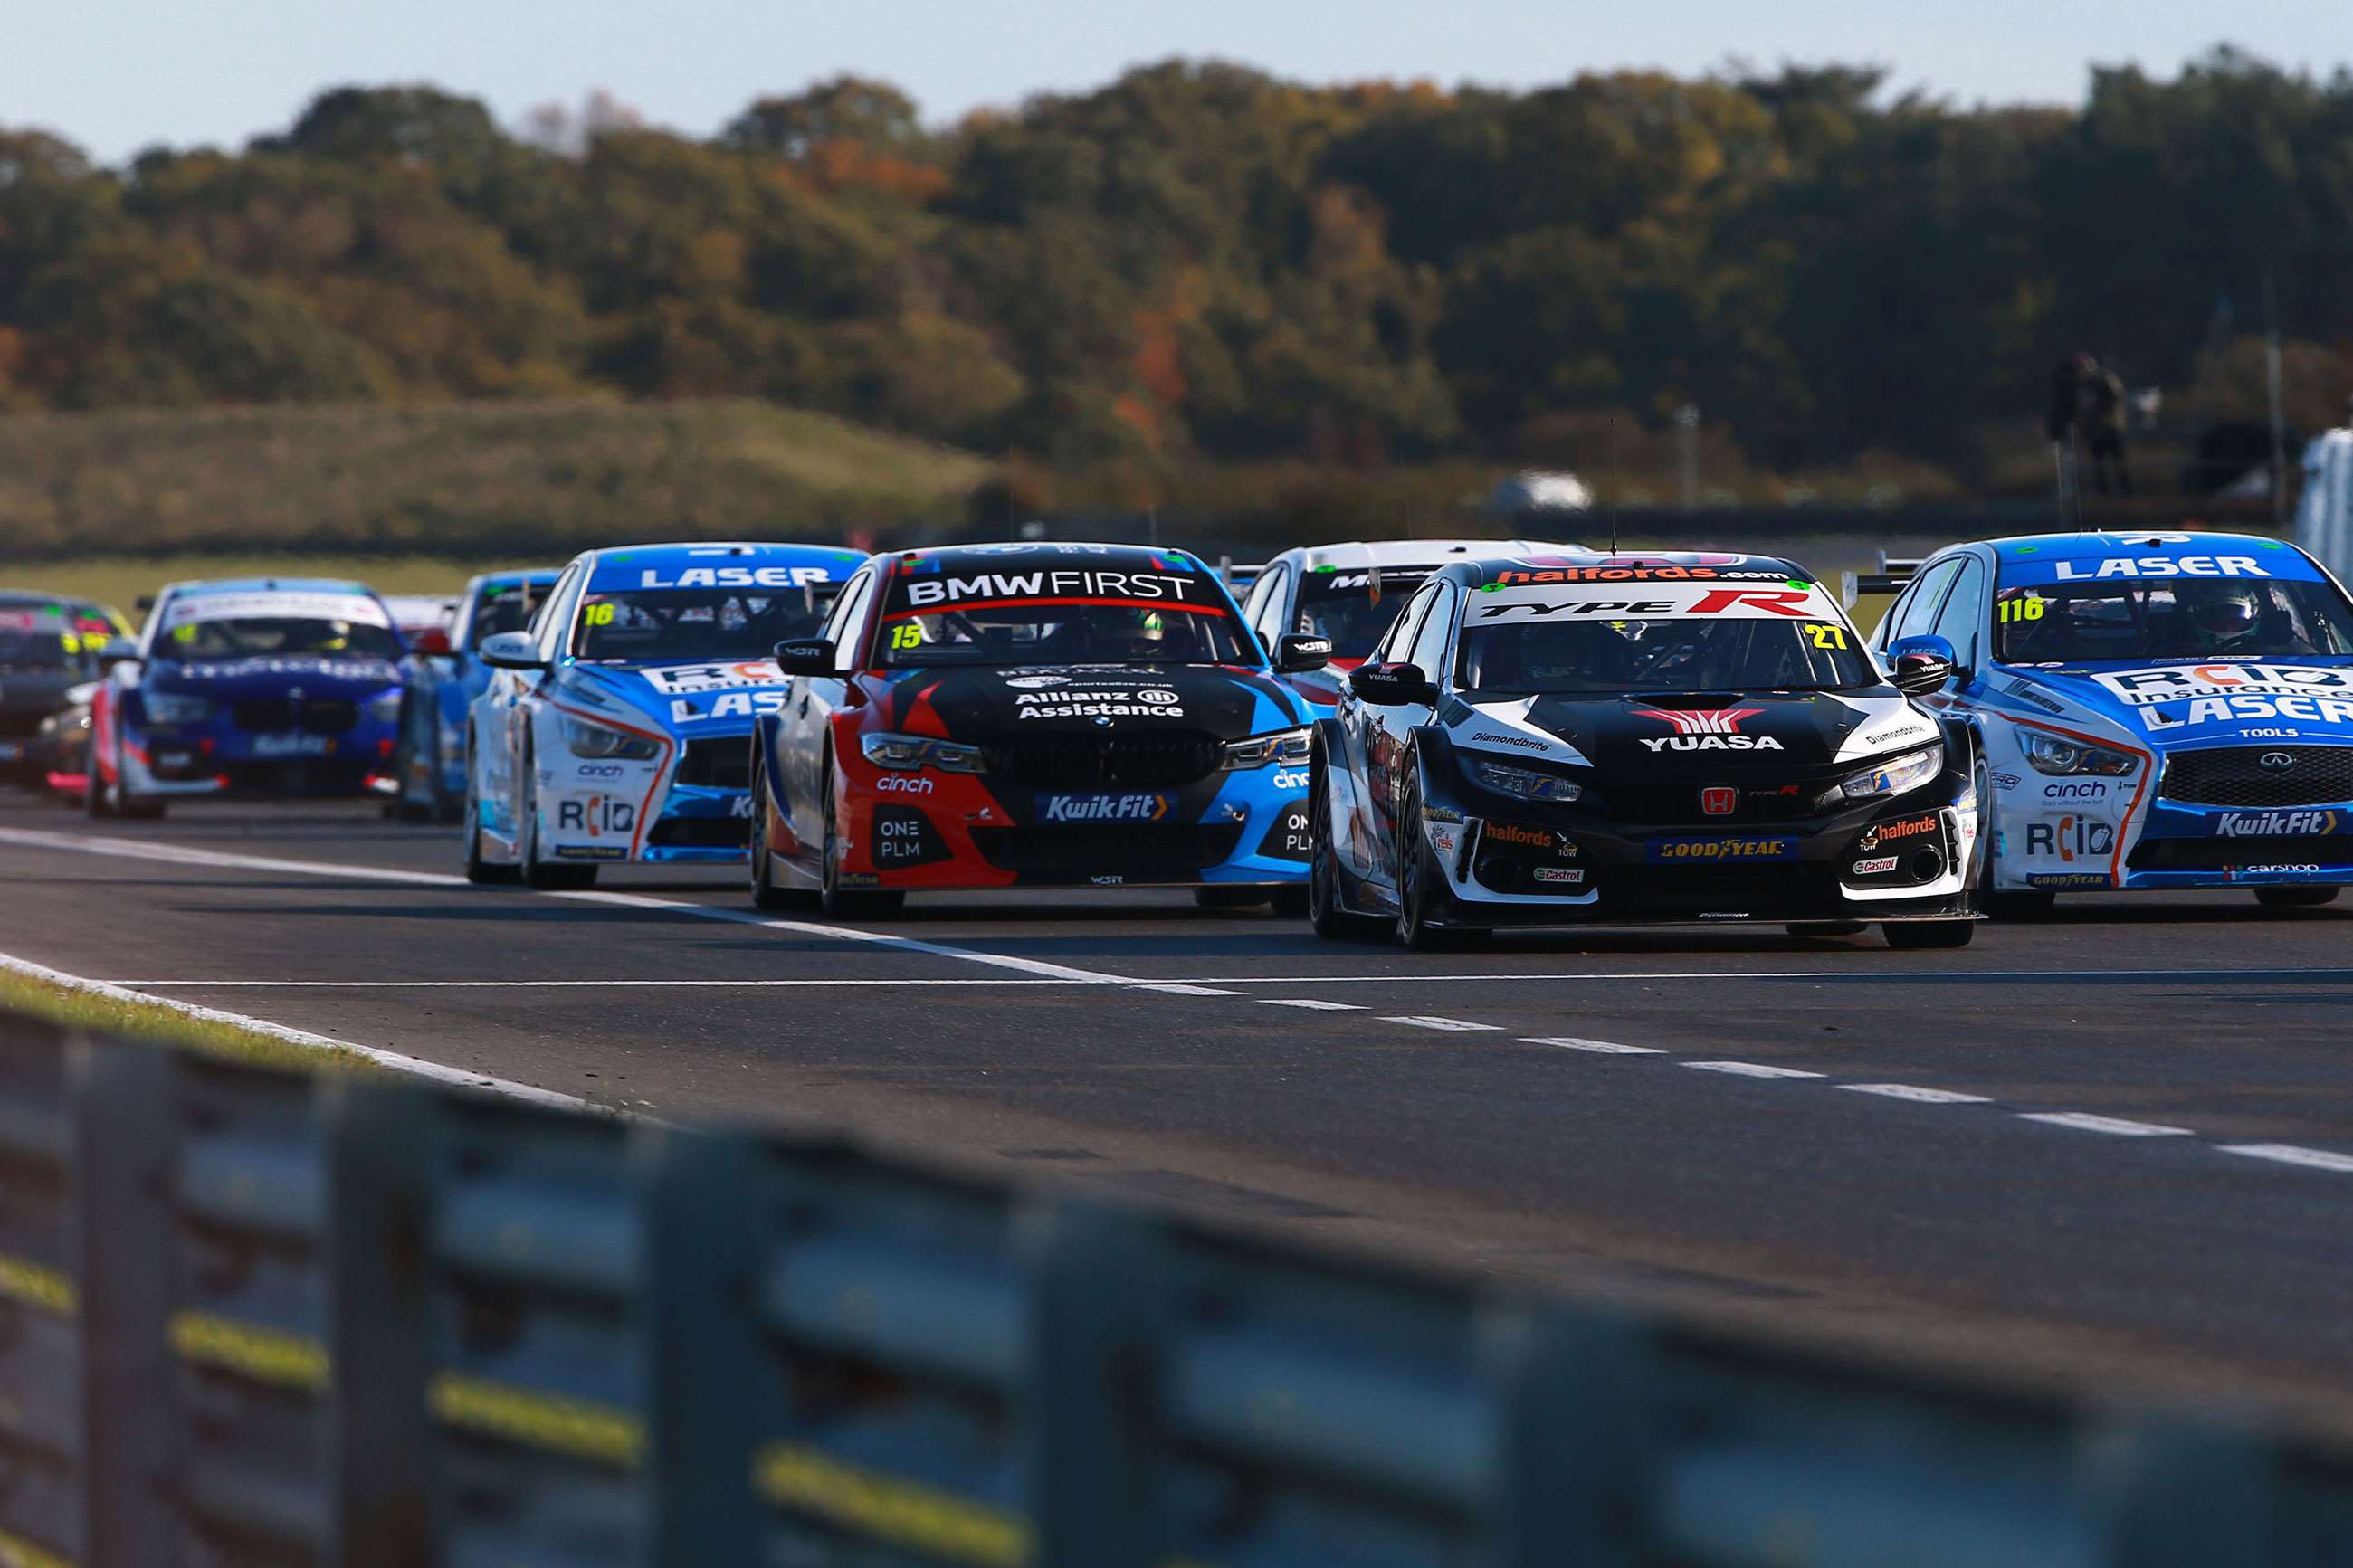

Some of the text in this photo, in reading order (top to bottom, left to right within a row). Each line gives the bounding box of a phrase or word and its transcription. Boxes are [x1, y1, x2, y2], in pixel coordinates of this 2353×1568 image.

[641, 567, 830, 587] LASER
[1498, 566, 1790, 584] halfords.com
[2055, 556, 2272, 580] LASER
[1480, 589, 1817, 618] TYPE R
[1997, 596, 2044, 623] 116
[586, 603, 615, 626] 16
[891, 625, 922, 649] 15
[1804, 624, 1847, 651] 27
[1368, 673, 1398, 682] YUASA
[1015, 691, 1130, 705] Allianz
[671, 692, 785, 723] LAS
[1018, 703, 1184, 719] Assistance
[2138, 696, 2353, 732] LASER
[1472, 731, 1549, 753] Diamondbrite
[2239, 728, 2299, 738] TOOLS
[1639, 736, 1785, 752] YUASA
[578, 765, 624, 776] cinch
[1273, 769, 1310, 789] cinc
[876, 773, 934, 794] cinch
[2044, 781, 2106, 797] cinch
[881, 821, 919, 836] ONE
[1486, 822, 1552, 847] halfords
[1879, 816, 1937, 841] halfords
[881, 841, 919, 857] PLM
[1558, 849, 1577, 857] TOW
[1661, 840, 1783, 859] GOODYEAR
[1545, 869, 1581, 881] Castrol
[1864, 860, 1894, 872] Castrol
[2247, 863, 2320, 876] carshop
[2034, 874, 2105, 886] GOODYEAR
